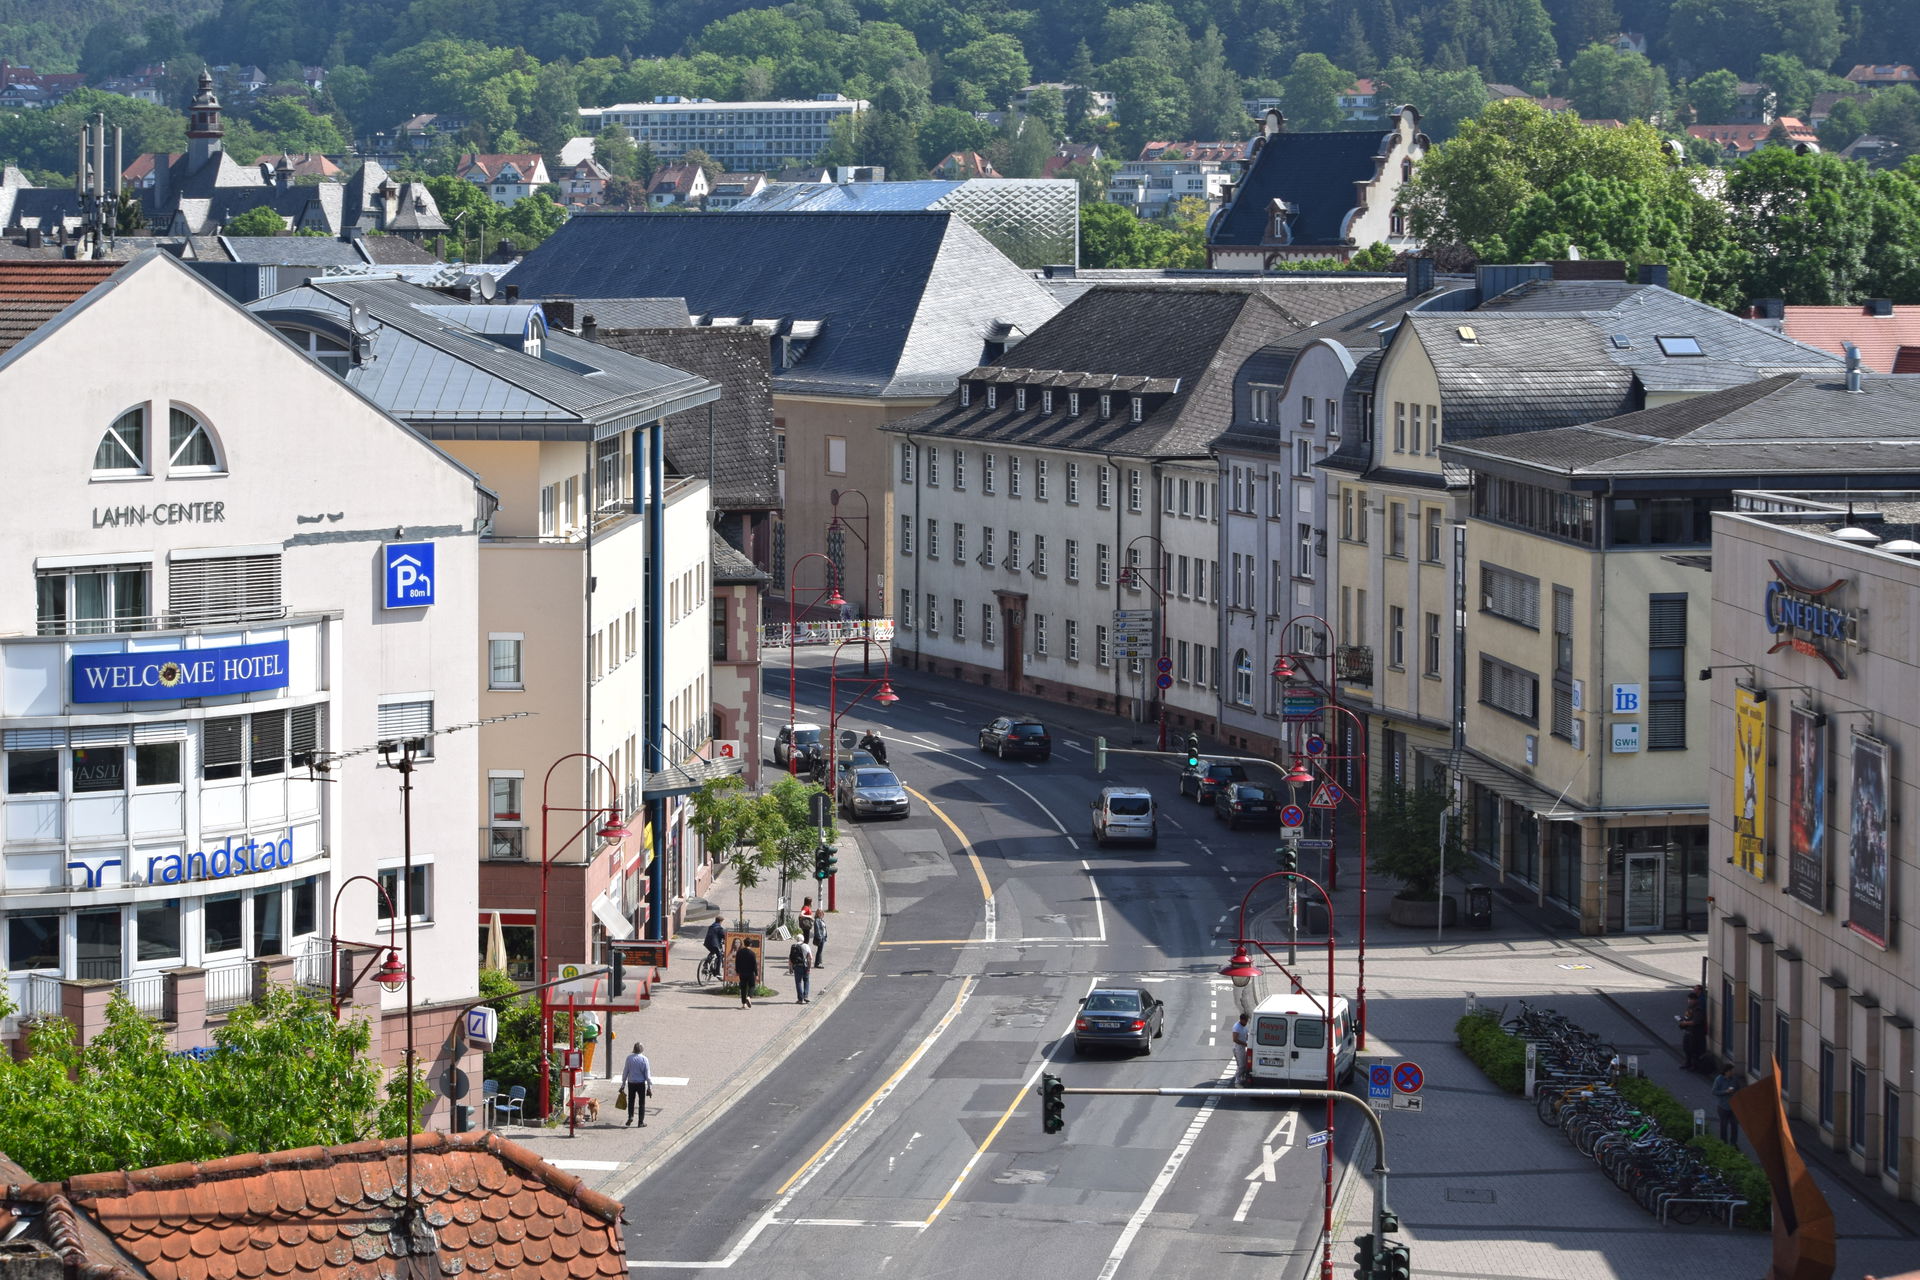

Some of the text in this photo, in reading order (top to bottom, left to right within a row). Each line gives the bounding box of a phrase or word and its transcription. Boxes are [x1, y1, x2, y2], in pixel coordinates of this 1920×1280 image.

[92, 501, 226, 529] LAHN-CENTER
[397, 565, 417, 598] P
[409, 588, 426, 598] 80m
[223, 654, 284, 682] HOTEL
[1615, 738, 1637, 747] GWH
[148, 826, 294, 885] randstad
[1371, 1087, 1390, 1096] TAXI
